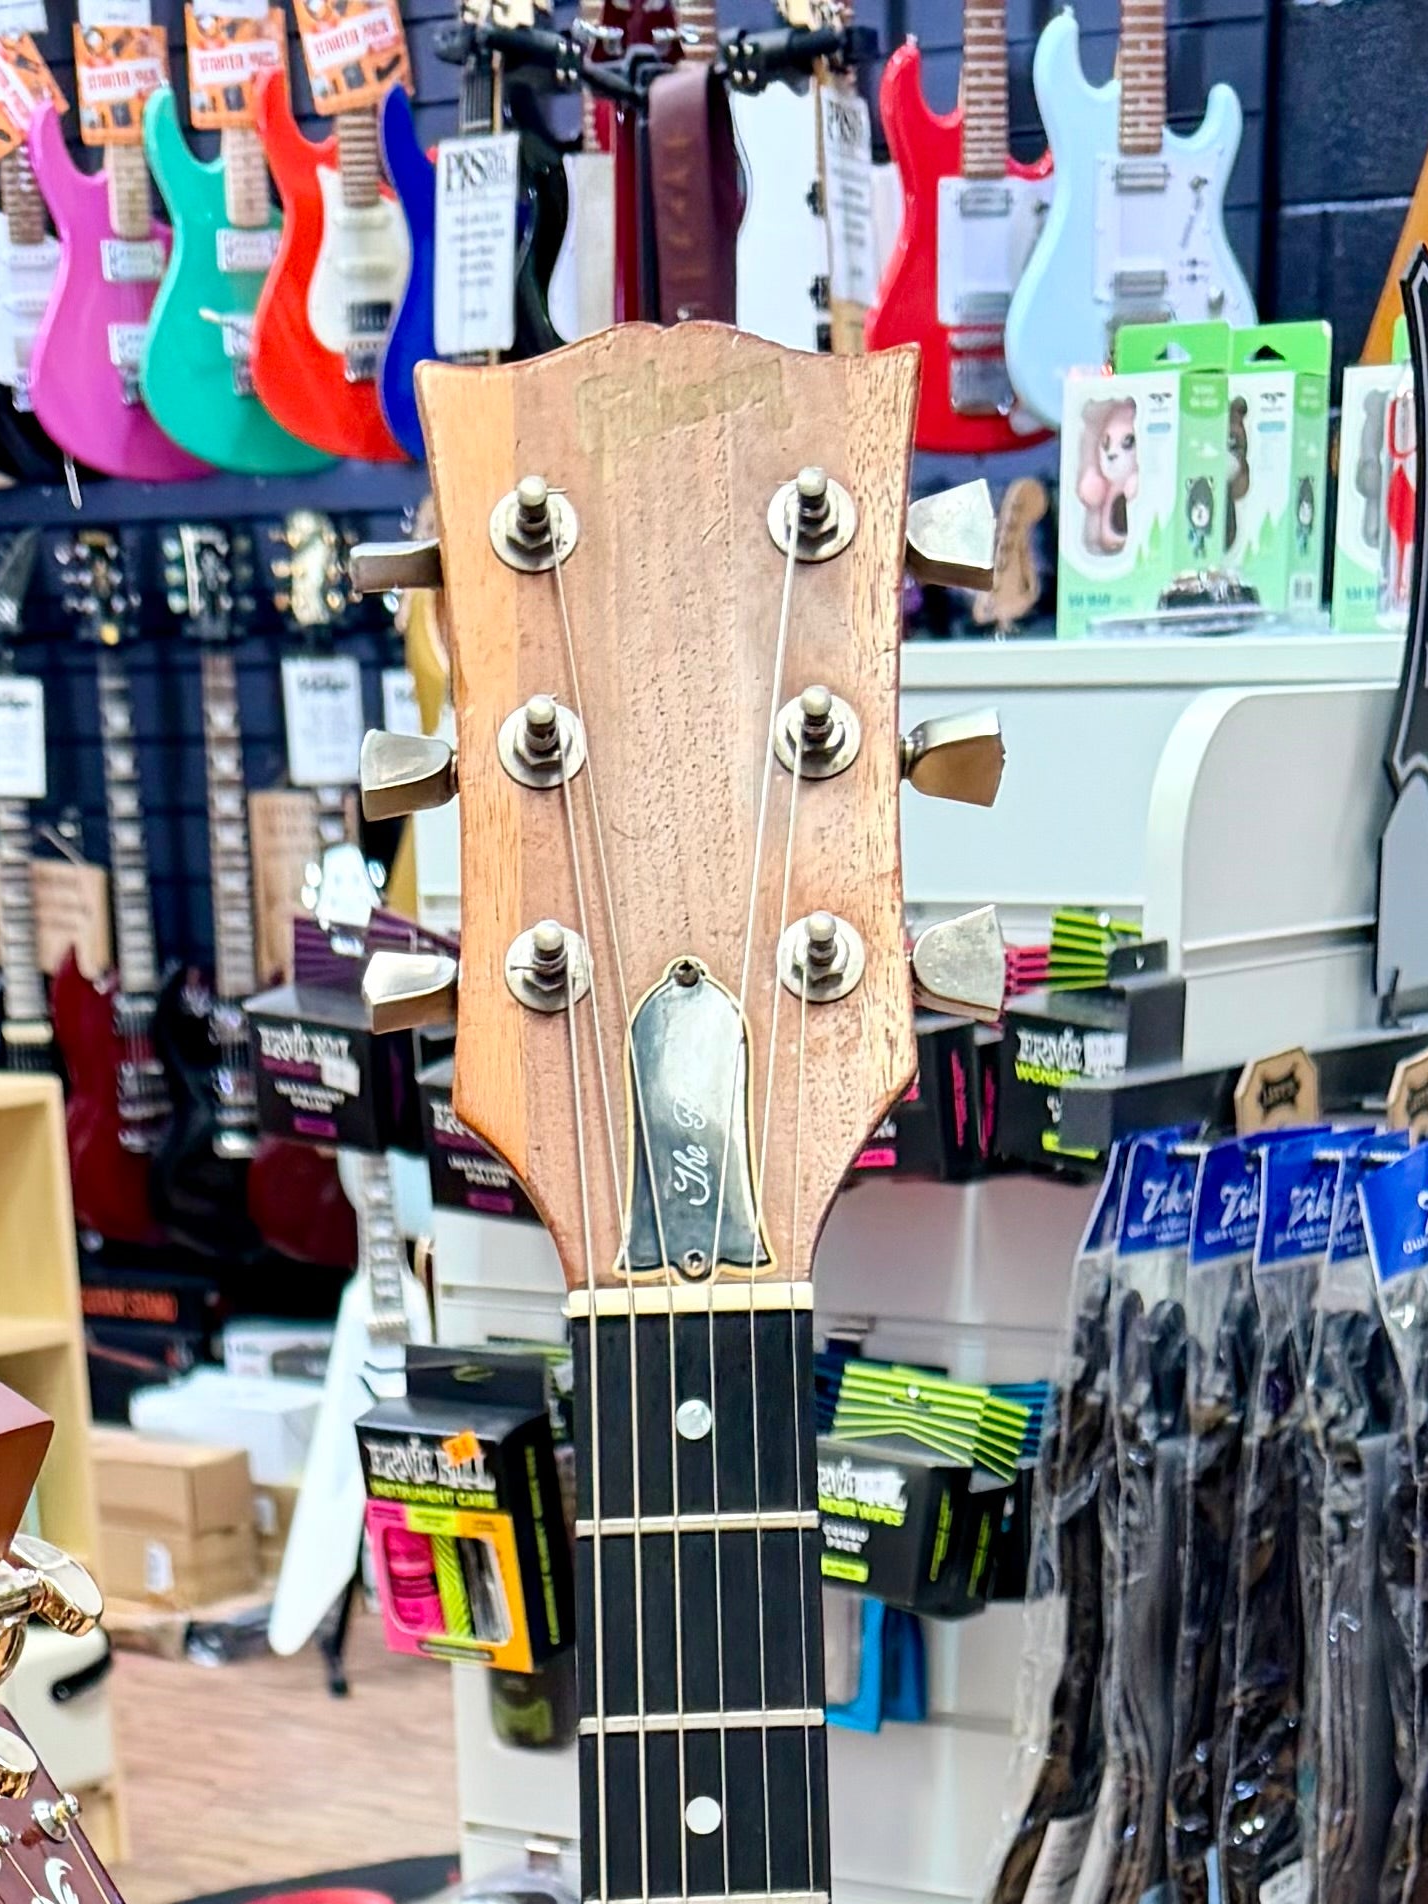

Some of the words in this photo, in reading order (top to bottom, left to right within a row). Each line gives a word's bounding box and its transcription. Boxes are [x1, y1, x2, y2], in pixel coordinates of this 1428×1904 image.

[1016, 1025, 1084, 1070] ERNIE
[672, 1144, 711, 1206] The
[364, 1434, 436, 1484] ERNIE
